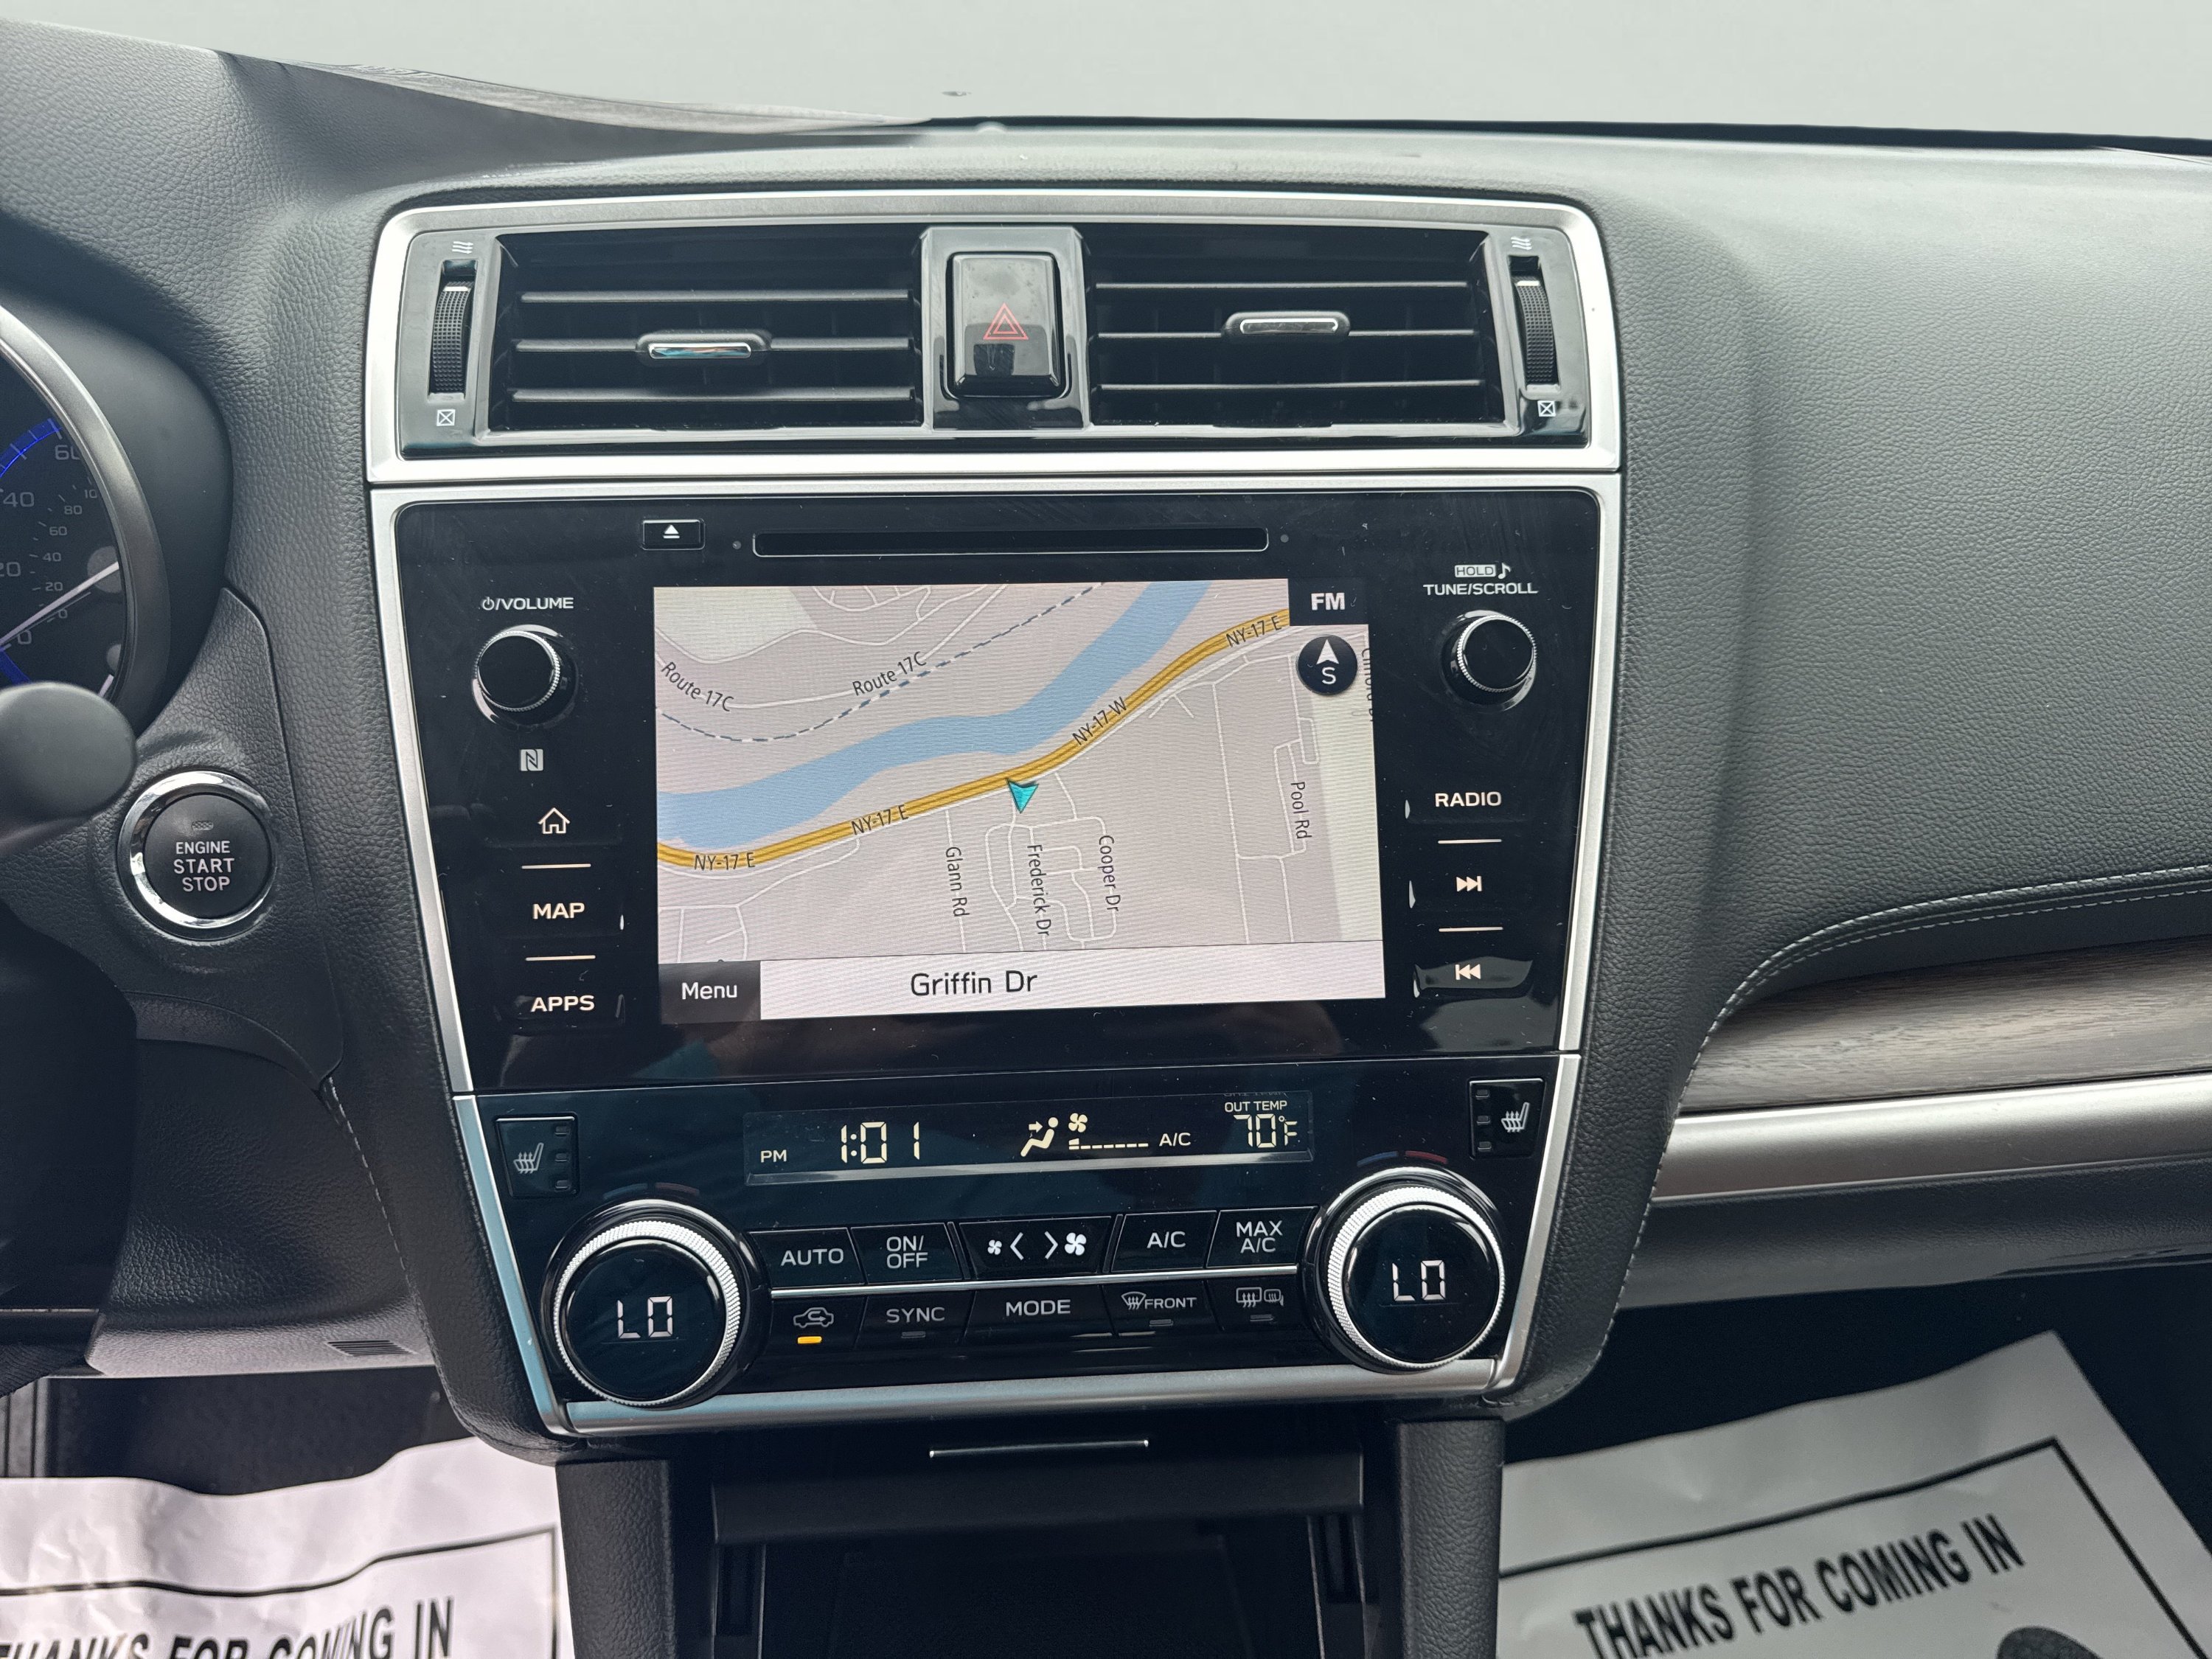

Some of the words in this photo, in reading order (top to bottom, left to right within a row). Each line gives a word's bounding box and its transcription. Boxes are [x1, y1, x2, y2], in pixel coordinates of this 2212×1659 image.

[3, 492, 34, 507] 40
[64, 505, 83, 515] 80
[49, 526, 67, 536] 60
[43, 552, 62, 561] 40
[1455, 566, 1495, 575] HOLD
[45, 582, 63, 591] 20
[1424, 582, 1538, 595] TUNE/SCROLL
[1311, 592, 1346, 611] FM
[1225, 621, 1267, 647] NY-17
[1271, 616, 1282, 630] E
[852, 669, 897, 695] Route
[897, 651, 928, 677] 17C
[1321, 667, 1337, 685] S
[661, 661, 701, 700] Route
[704, 690, 734, 712] 17C
[1071, 710, 1110, 746] NY-17
[1109, 695, 1127, 715] W
[1290, 781, 1309, 813] Pool
[1435, 792, 1502, 807] RADIO
[851, 809, 892, 835] NY-17
[897, 804, 909, 821] E
[1294, 817, 1312, 840] Rd
[175, 841, 230, 854] ENGINE
[173, 858, 234, 874] START
[693, 854, 738, 870] NY-17
[745, 852, 755, 868] E
[945, 846, 963, 891] Glann
[1098, 835, 1118, 889] Cooper
[182, 876, 230, 891] STOP
[1027, 844, 1051, 914] Frederick
[532, 903, 585, 919] MAP
[951, 897, 970, 917] Rd
[1105, 894, 1121, 912] Dr
[1035, 919, 1052, 936] Dr
[681, 982, 737, 999] Menu
[910, 972, 992, 996] Griffin
[1004, 970, 1038, 993] Dr
[530, 996, 594, 1012] APPS
[1225, 1101, 1251, 1113] OUT
[1253, 1100, 1287, 1111] TEMP
[1159, 1133, 1192, 1147] A/C
[760, 1150, 787, 1163] PM
[1236, 1221, 1283, 1238] MAX
[886, 1235, 924, 1253] ON/
[1147, 1231, 1186, 1249] A/C
[1240, 1237, 1276, 1253] A/C
[780, 1247, 844, 1265] AUTO
[886, 1253, 928, 1269] OFF
[1006, 1300, 1071, 1318] MODE
[1144, 1296, 1197, 1310] FRONT
[886, 1308, 945, 1323] SYNC
[1572, 1584, 1735, 1659] THANKS
[1730, 1566, 1822, 1634] FOR
[1814, 1528, 1970, 1614] COMING
[1960, 1513, 2025, 1576] IN
[414, 1598, 454, 1659] IN
